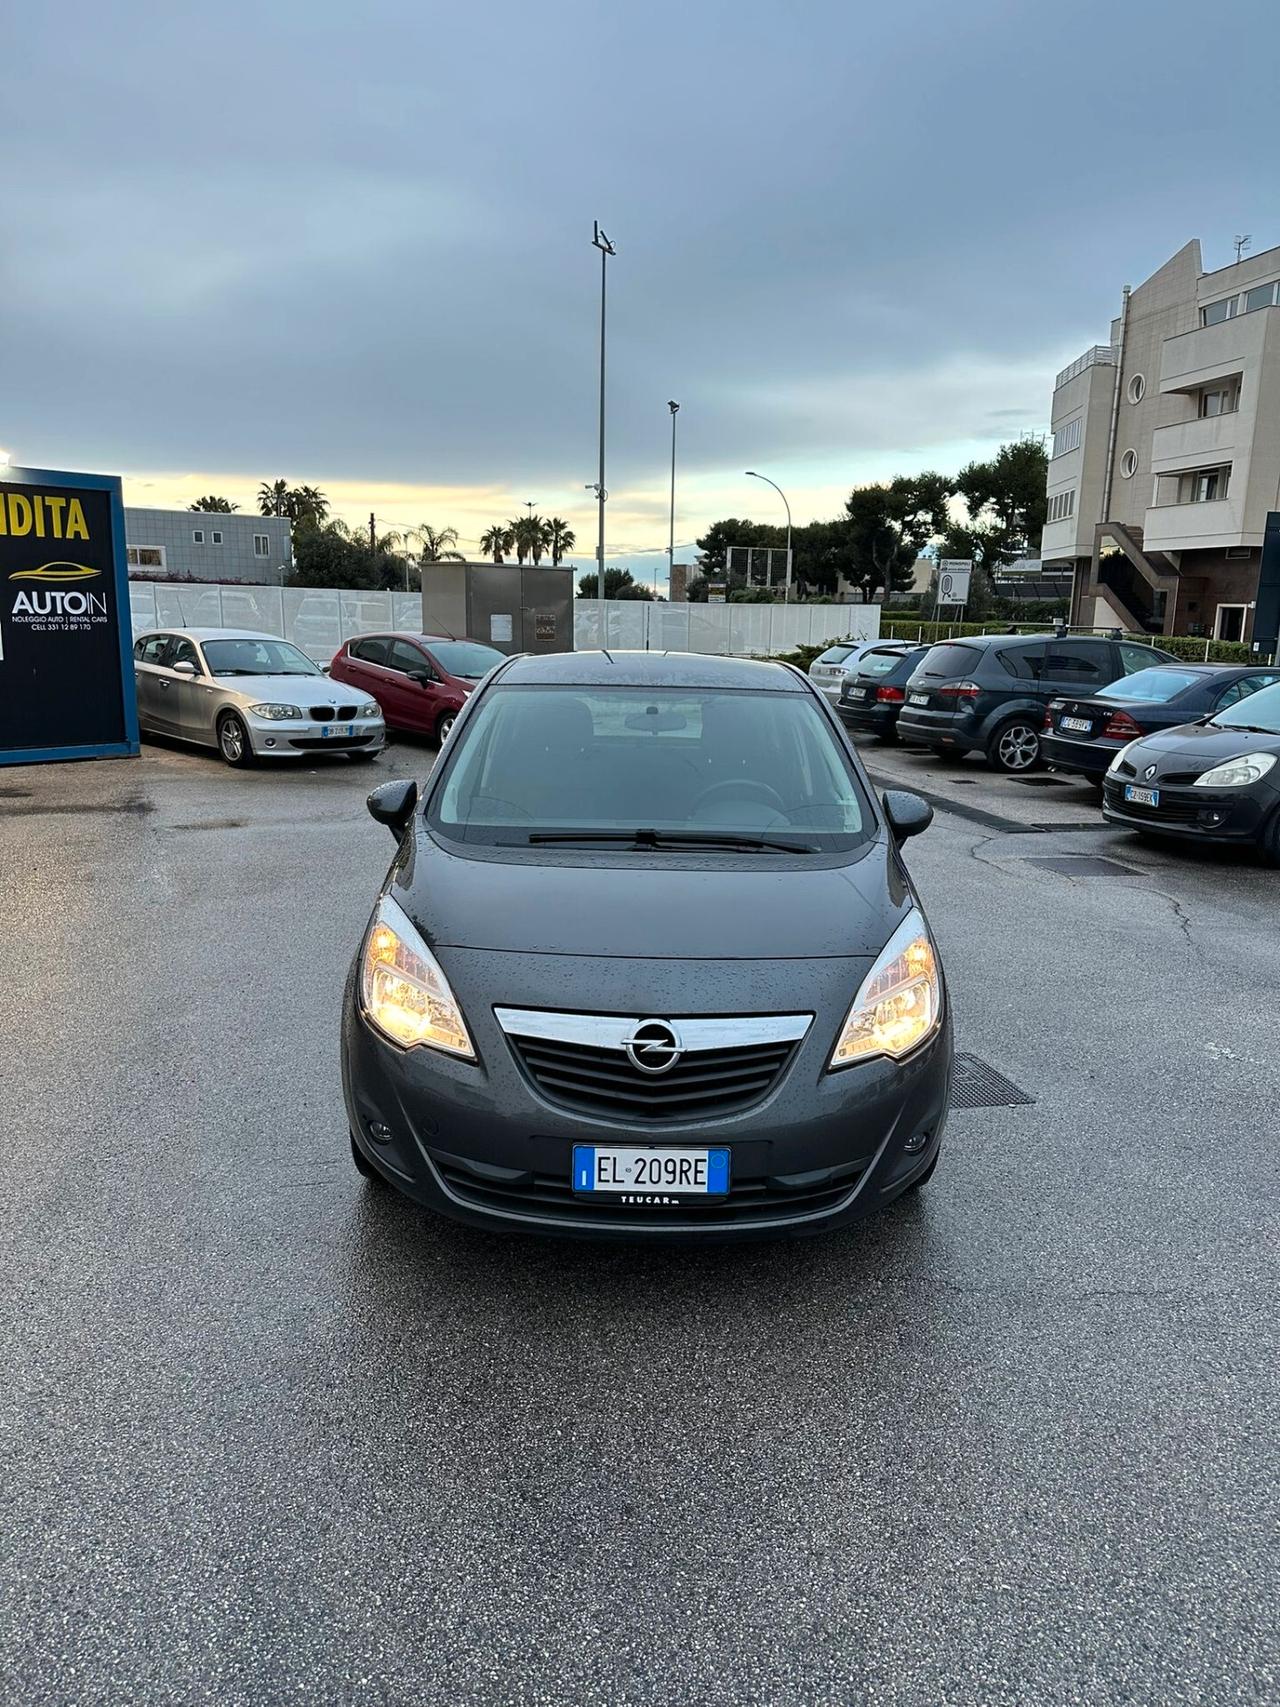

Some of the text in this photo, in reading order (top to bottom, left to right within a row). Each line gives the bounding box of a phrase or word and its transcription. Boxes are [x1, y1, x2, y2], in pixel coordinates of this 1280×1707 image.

[0, 493, 90, 540] DITA
[597, 1156, 707, 1185] EL 209RE
[621, 1196, 669, 1204] TEUCAR
